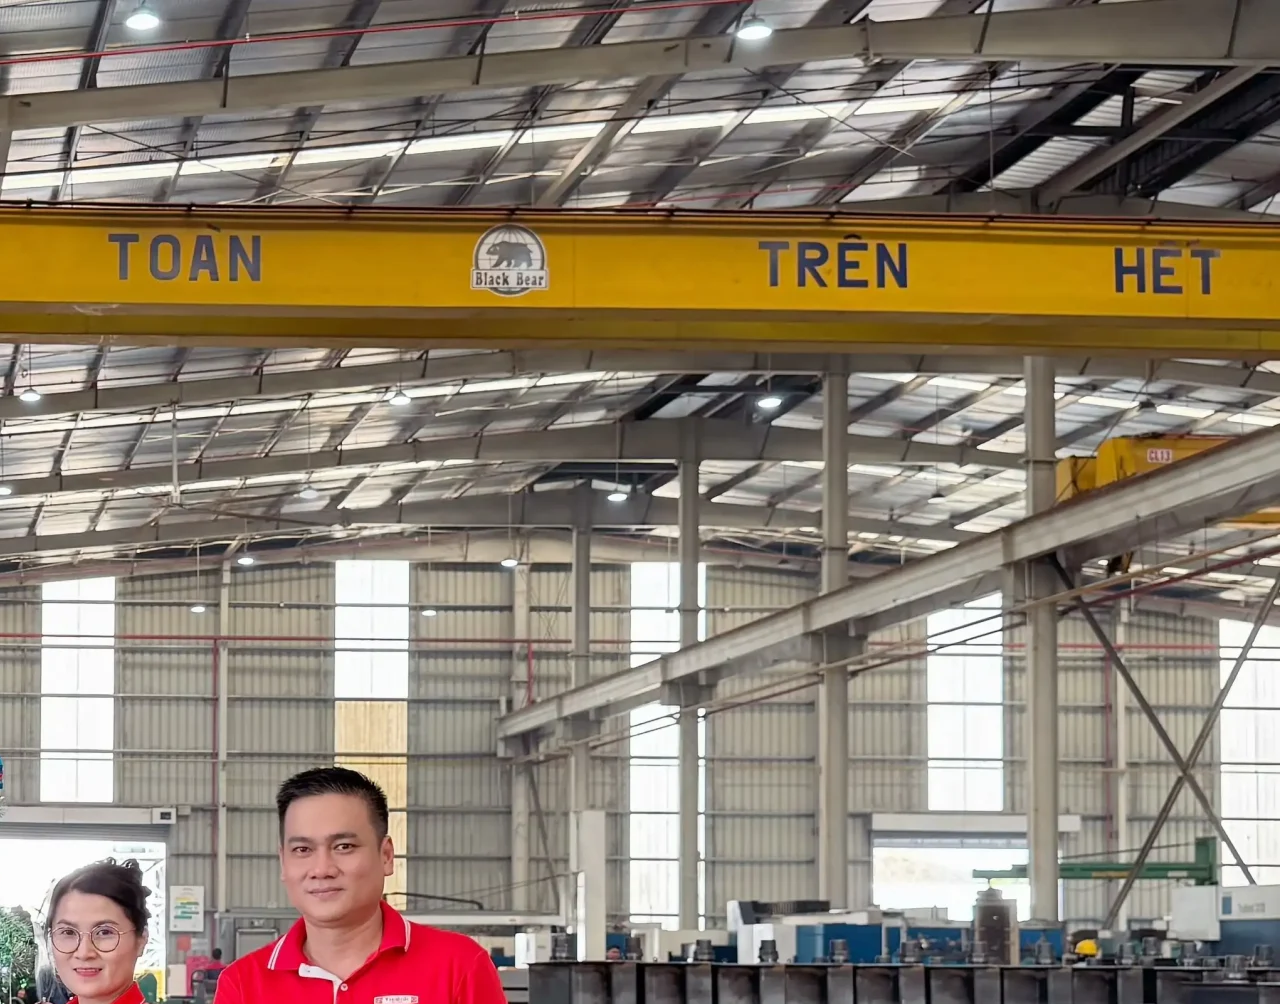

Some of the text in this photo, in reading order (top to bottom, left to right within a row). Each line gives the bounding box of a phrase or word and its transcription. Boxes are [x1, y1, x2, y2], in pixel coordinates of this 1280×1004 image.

[475, 271, 544, 286] Black Bear
[758, 233, 908, 289] TRÊN
